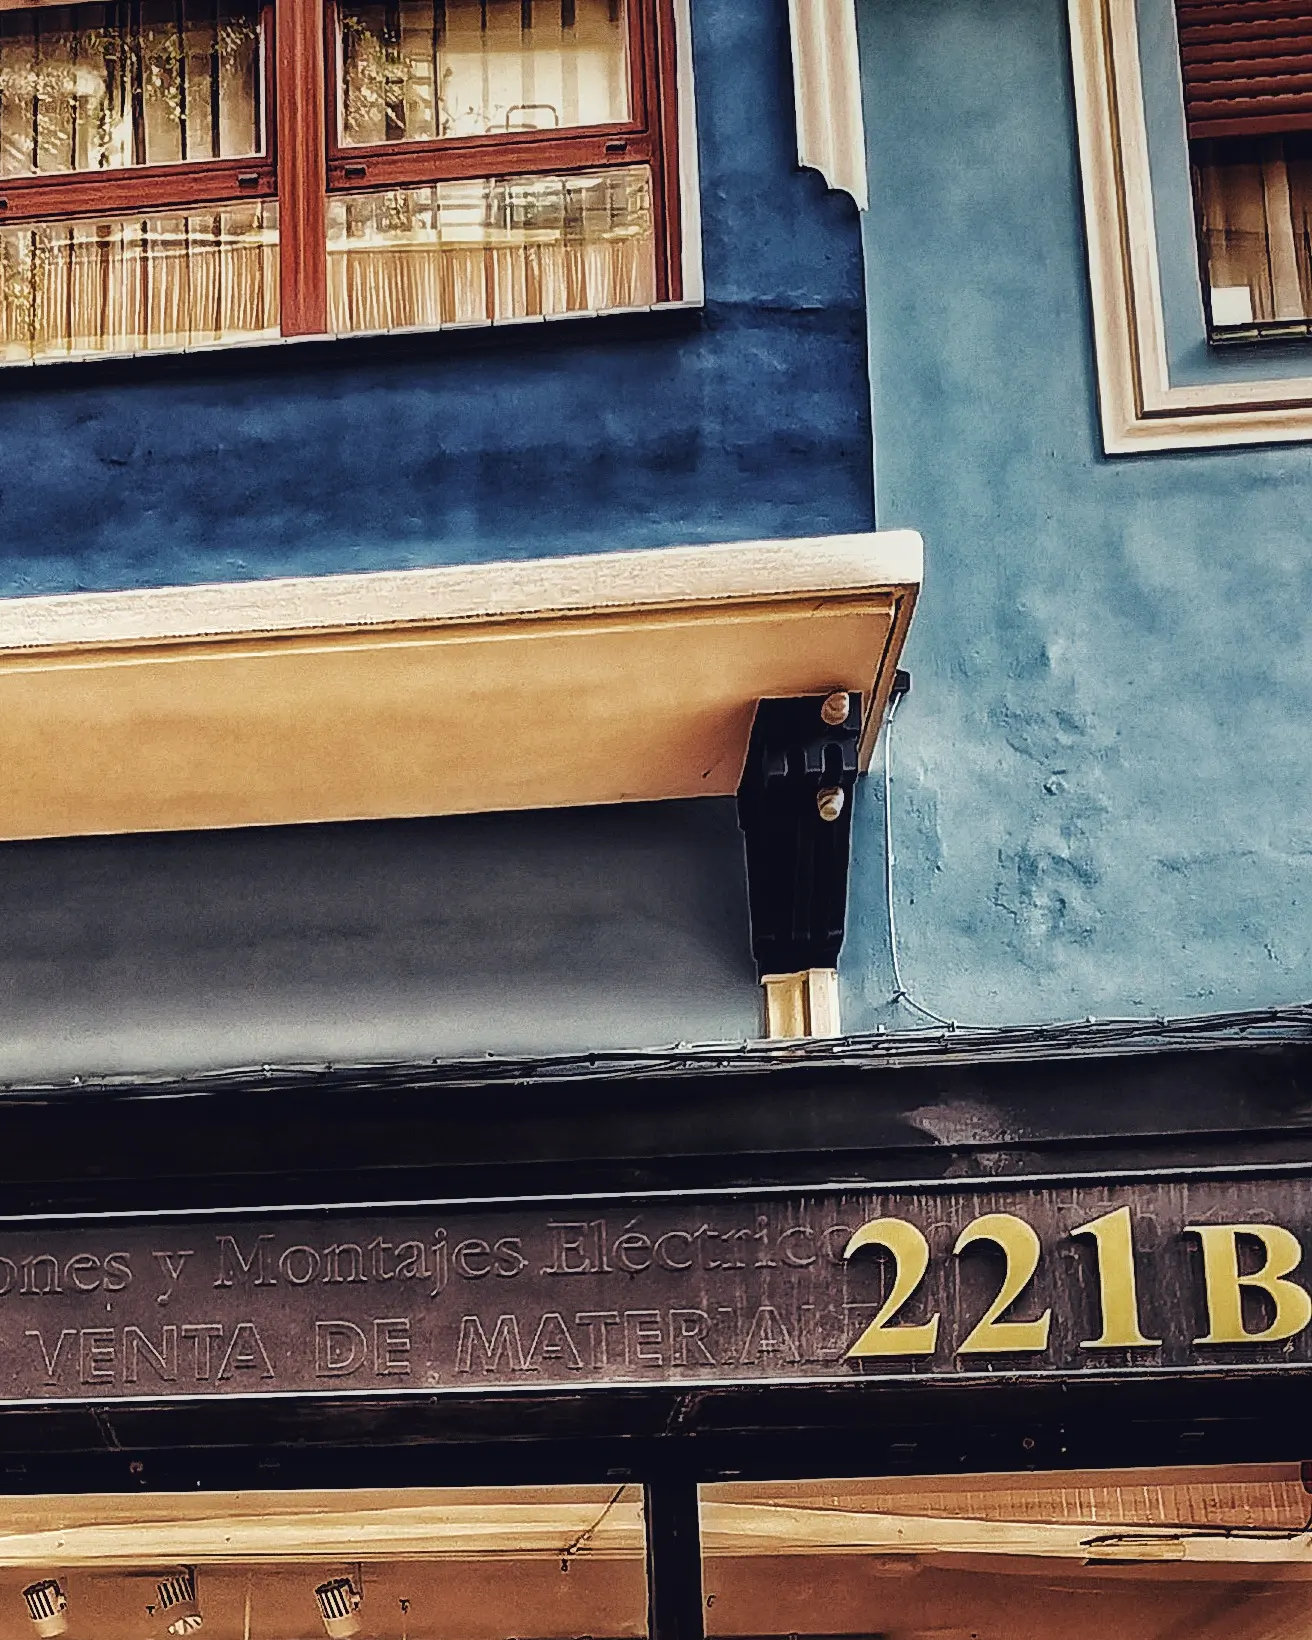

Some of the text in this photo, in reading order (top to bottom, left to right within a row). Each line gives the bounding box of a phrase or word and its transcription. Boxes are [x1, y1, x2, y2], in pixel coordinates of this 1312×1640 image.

[151, 1250, 195, 1305] y
[213, 1228, 529, 1298] Montajes
[25, 1322, 275, 1386] VENTA
[315, 1318, 411, 1376] DE
